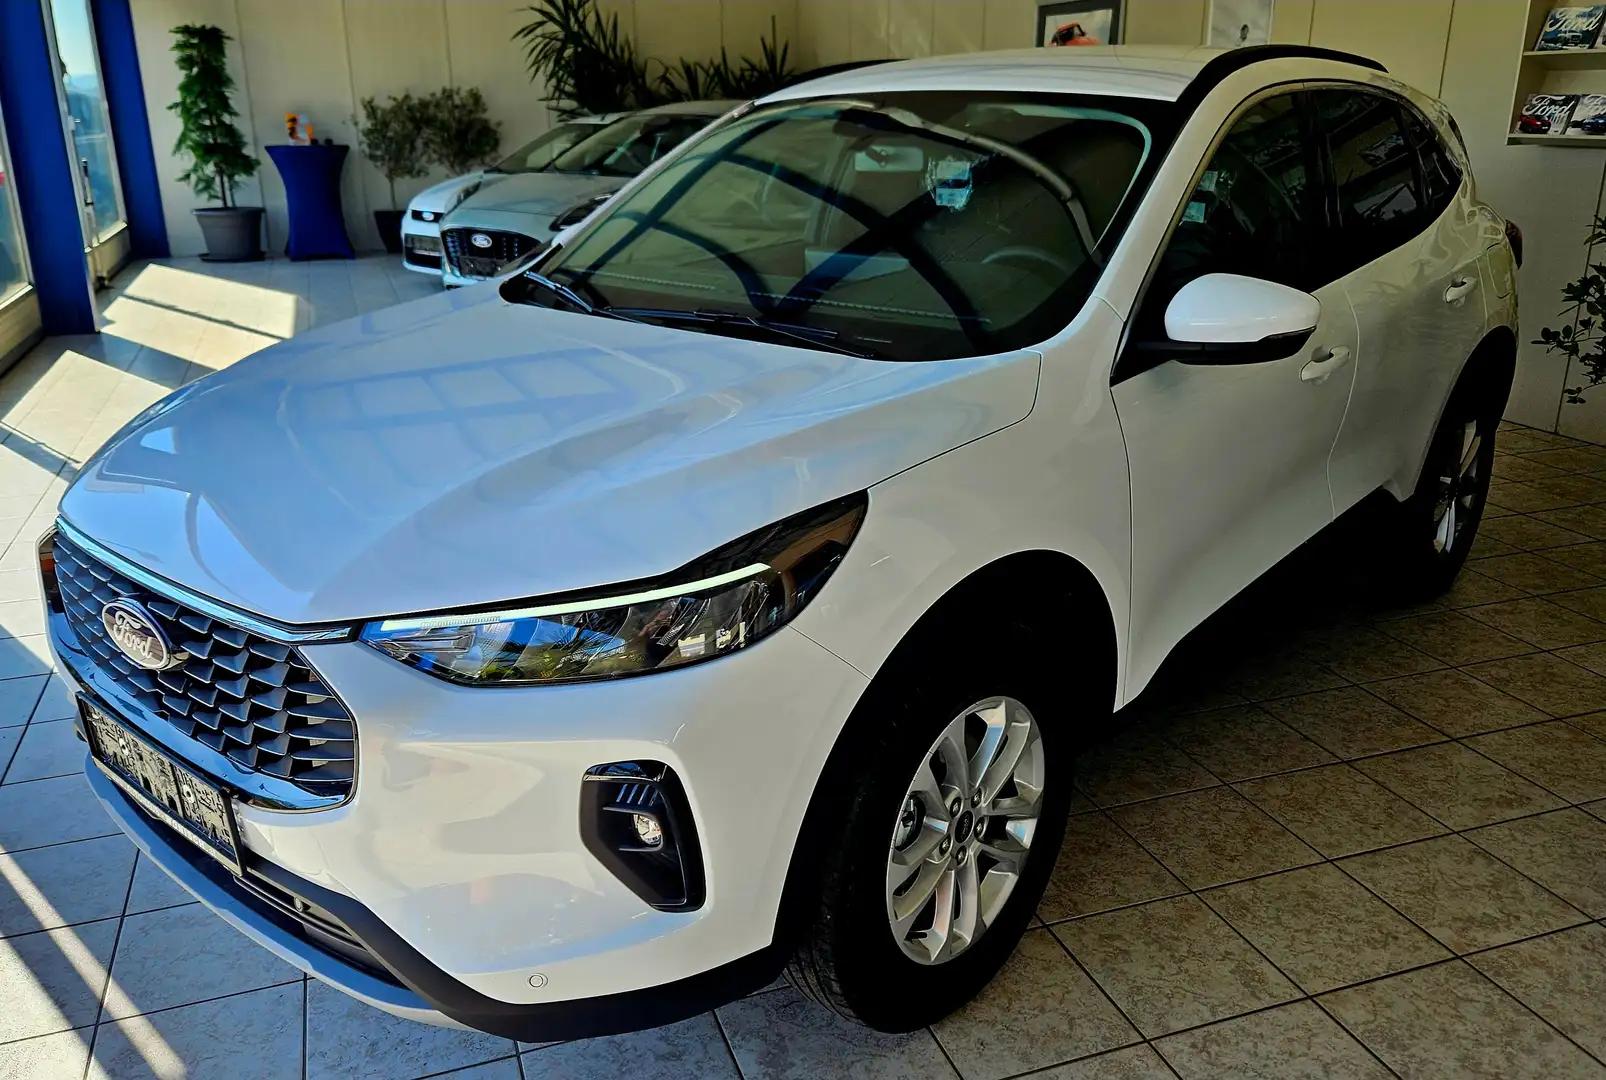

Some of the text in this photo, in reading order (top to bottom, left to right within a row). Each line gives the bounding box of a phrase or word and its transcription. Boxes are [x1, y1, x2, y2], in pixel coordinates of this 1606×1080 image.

[1545, 6, 1603, 32] Ford
[1521, 95, 1575, 118] Ford
[113, 609, 153, 659] Ford
